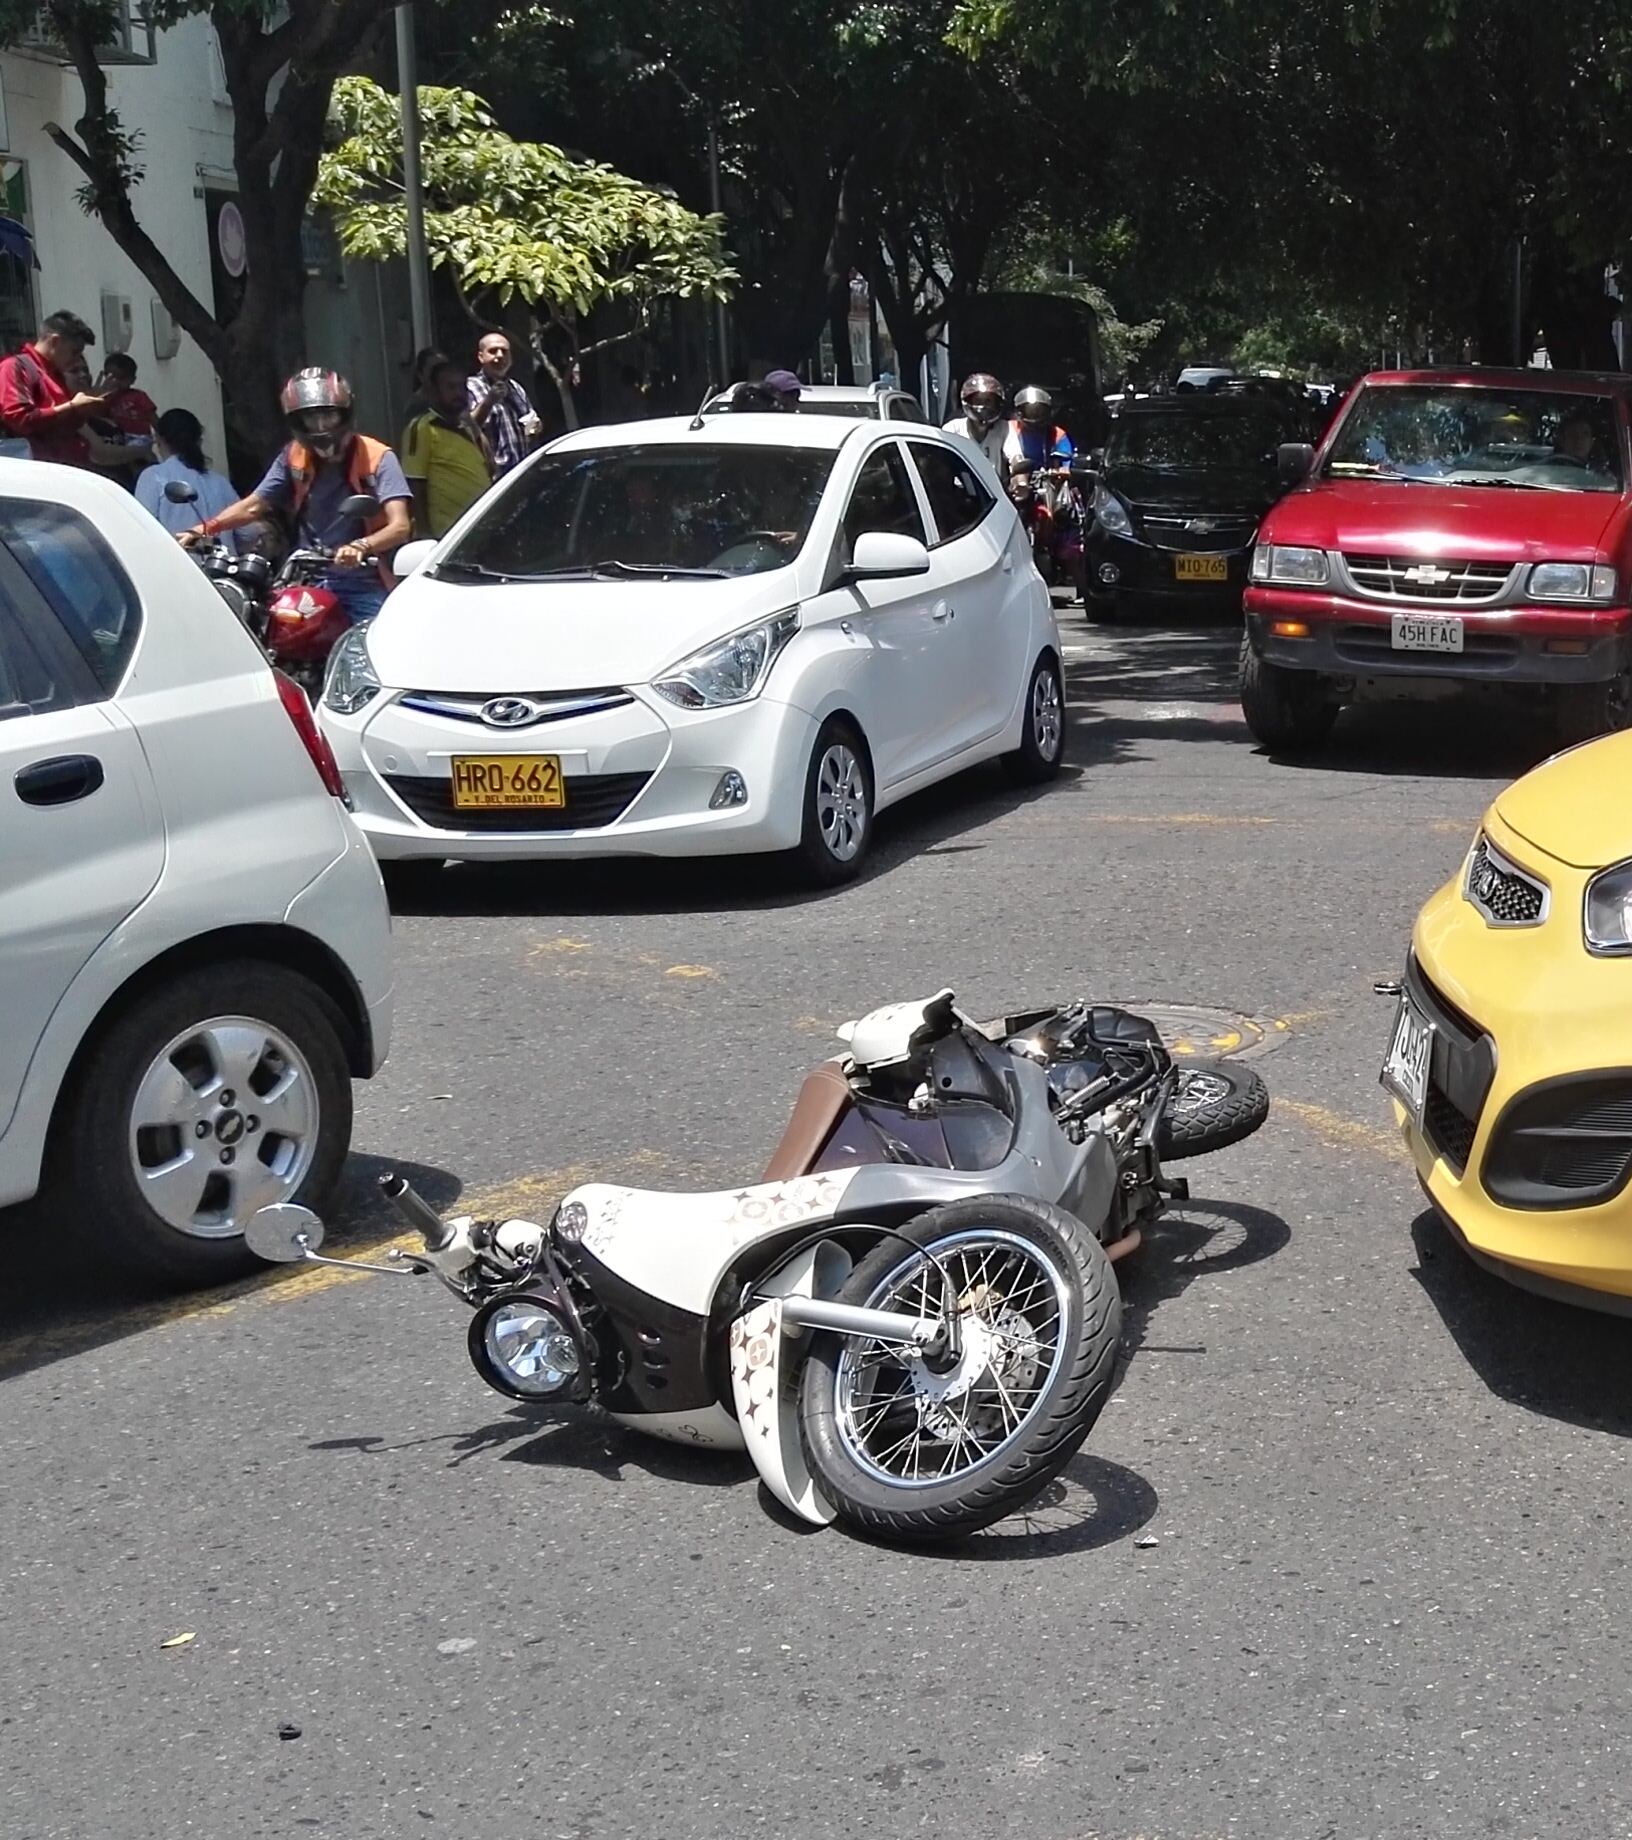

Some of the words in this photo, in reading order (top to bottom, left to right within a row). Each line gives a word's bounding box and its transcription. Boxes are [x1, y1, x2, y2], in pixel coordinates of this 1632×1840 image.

[1399, 625, 1426, 642] 45H
[1430, 626, 1458, 644] FAC
[485, 794, 500, 803] DEL
